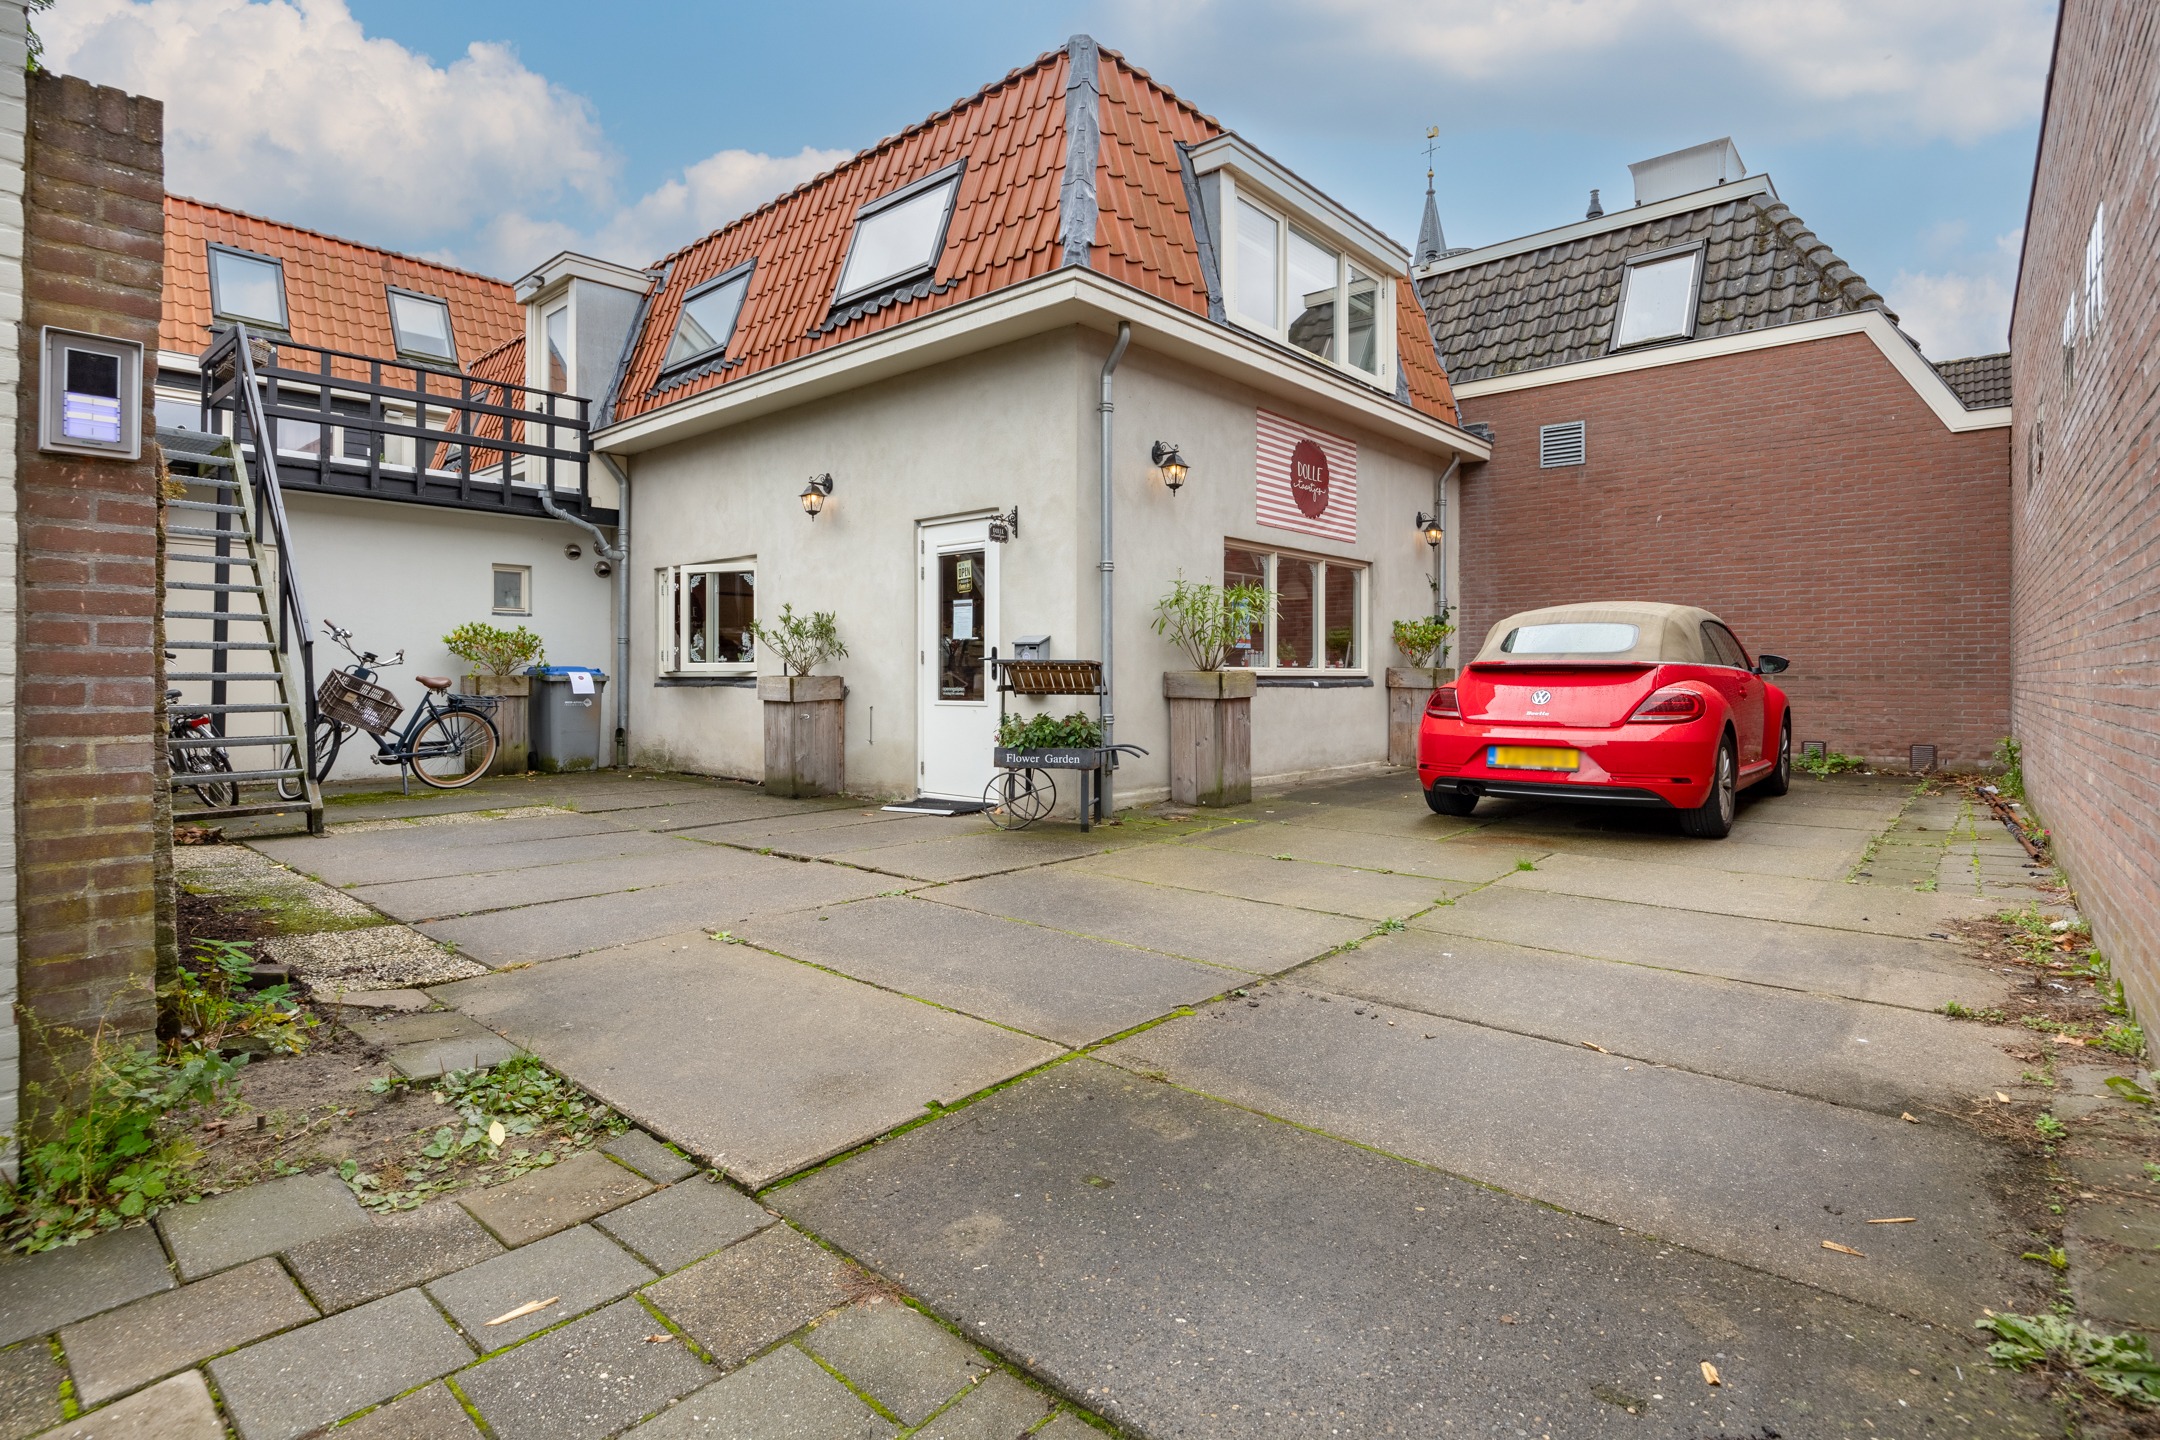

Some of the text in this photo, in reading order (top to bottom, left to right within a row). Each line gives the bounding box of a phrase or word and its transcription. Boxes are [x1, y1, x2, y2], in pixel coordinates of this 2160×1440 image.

[1297, 461, 1323, 482] DOLLE
[958, 567, 971, 578] OPEN
[1006, 753, 1080, 764] Flower Garden
